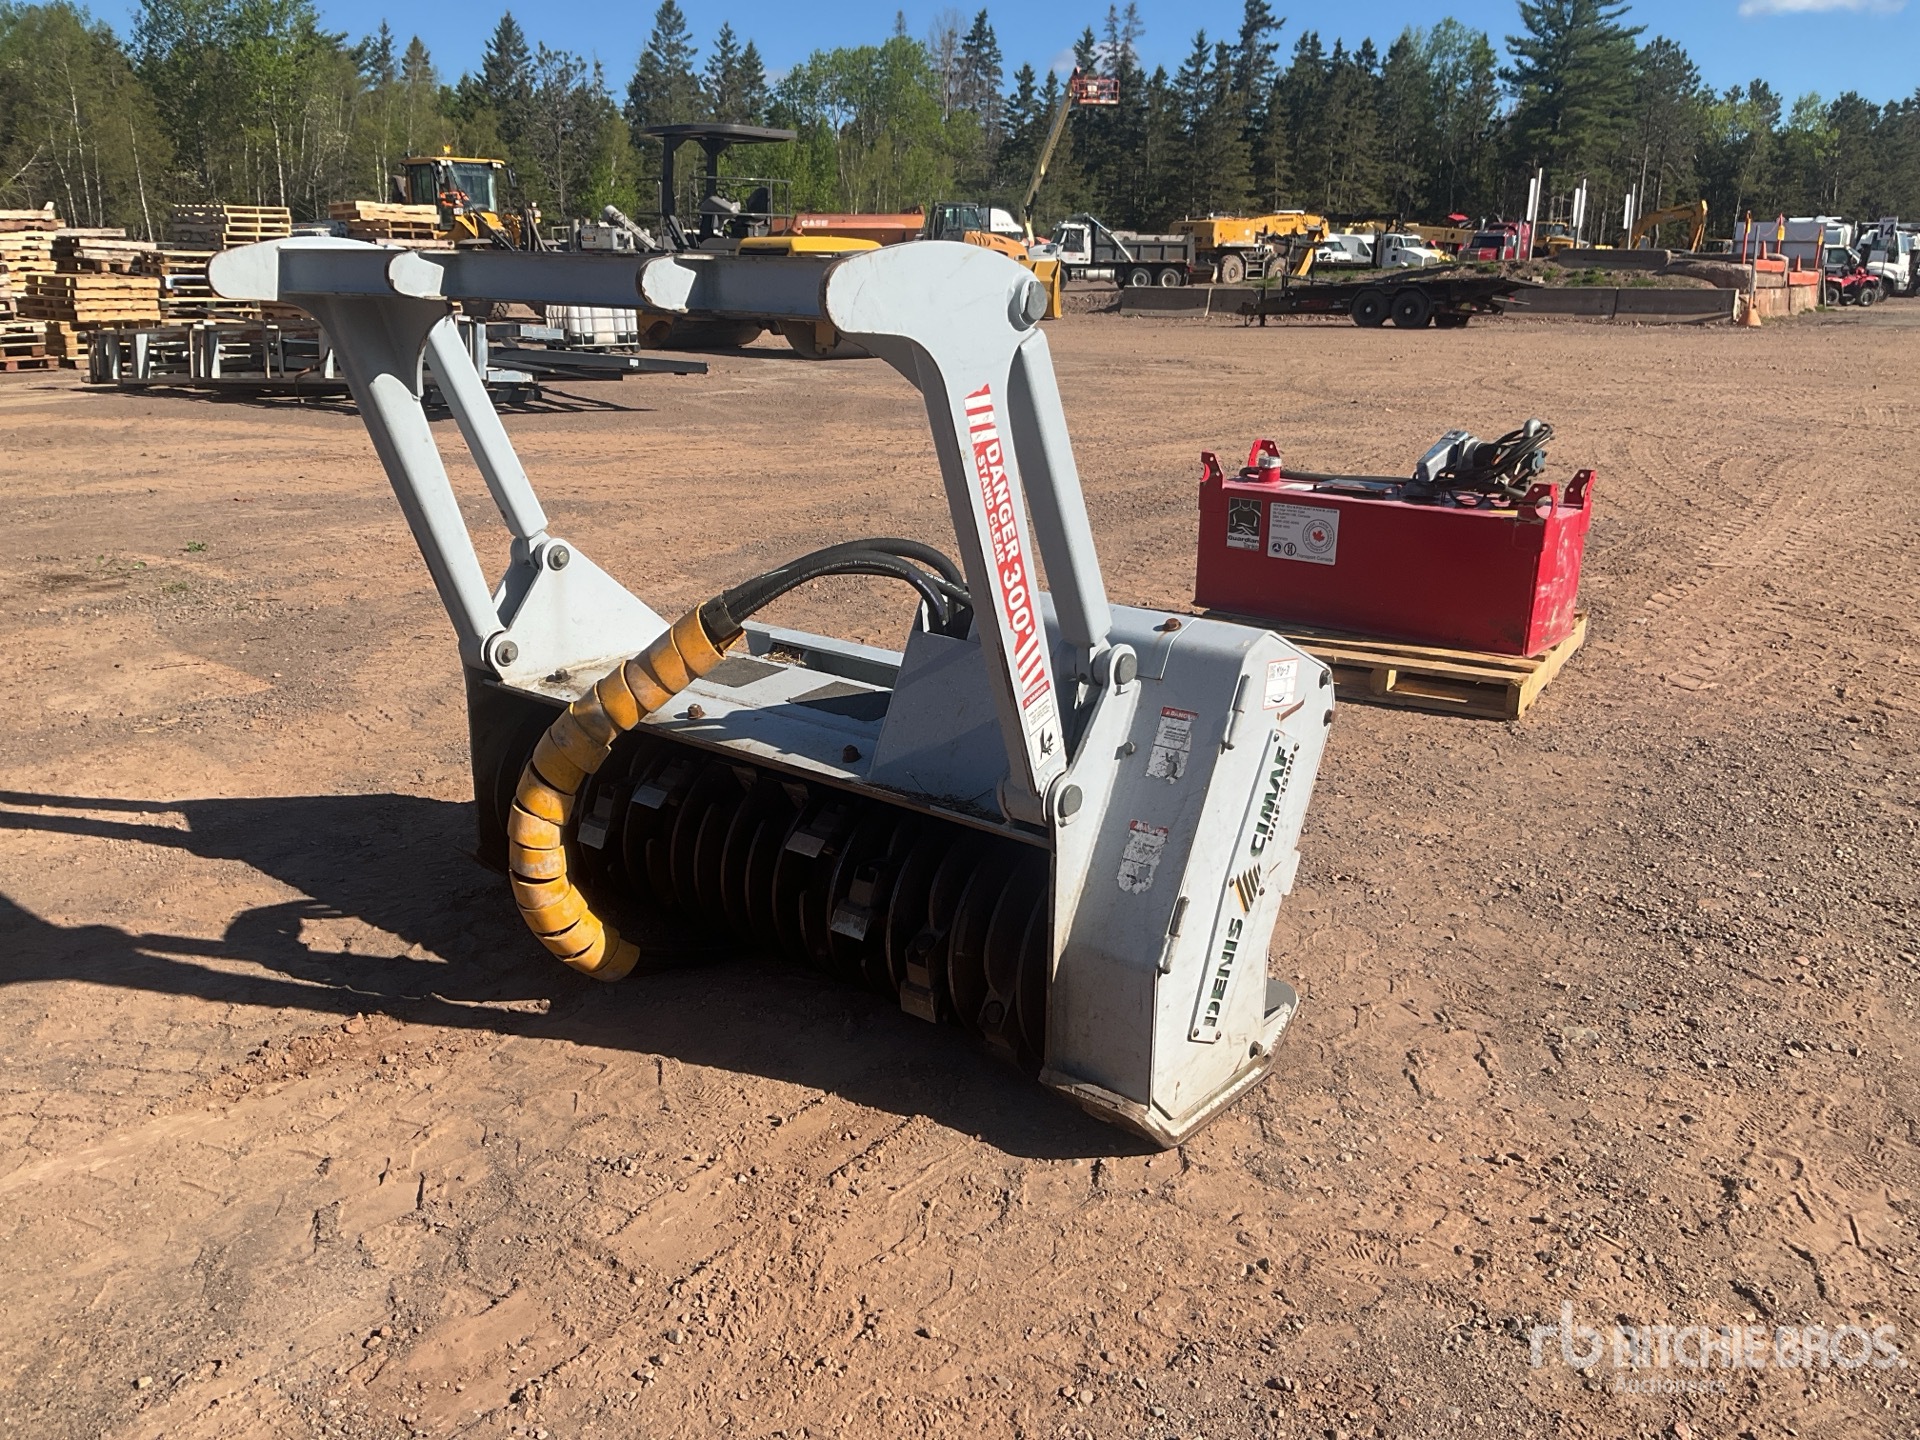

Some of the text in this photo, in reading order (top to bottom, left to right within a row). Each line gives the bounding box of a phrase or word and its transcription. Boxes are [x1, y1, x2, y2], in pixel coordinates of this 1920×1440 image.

[801, 219, 829, 227] CASE
[1880, 224, 1894, 238] 14
[978, 455, 1006, 565] STAND CLEAR
[986, 441, 1020, 562] DANGER
[1228, 535, 1260, 543] Guardian
[1250, 745, 1288, 857] CIMAF
[1203, 917, 1243, 1027] DENIS
